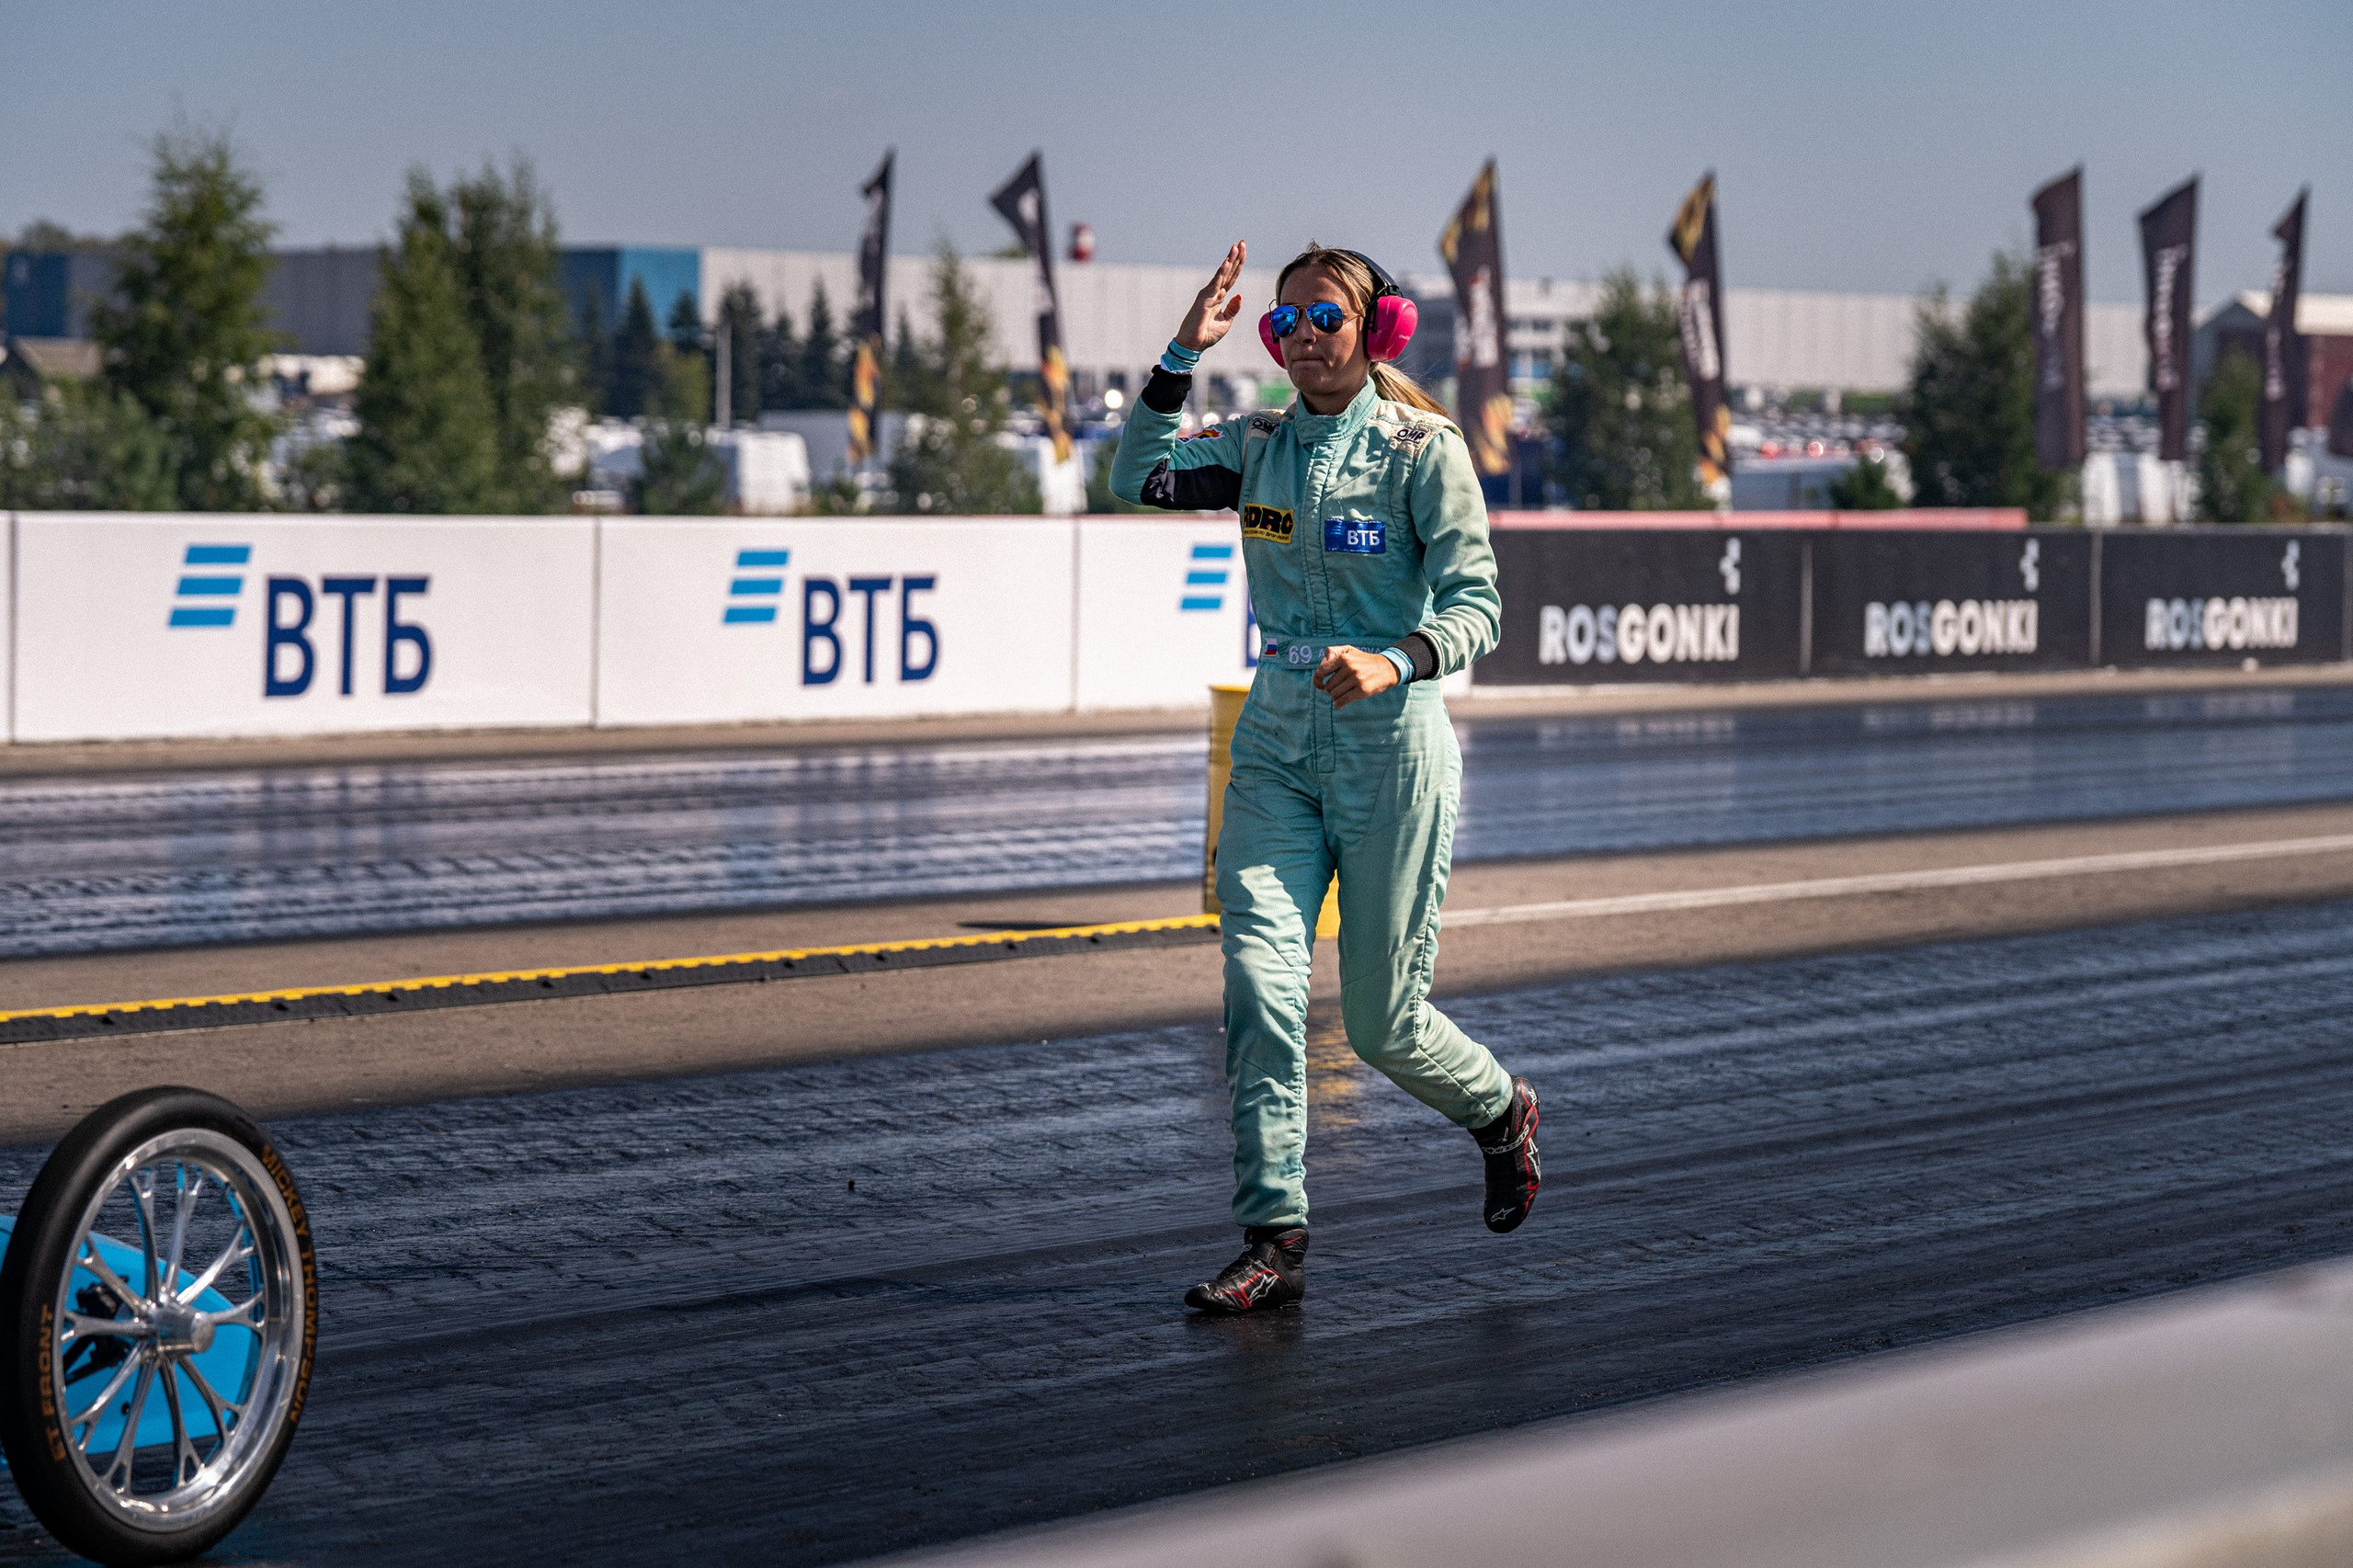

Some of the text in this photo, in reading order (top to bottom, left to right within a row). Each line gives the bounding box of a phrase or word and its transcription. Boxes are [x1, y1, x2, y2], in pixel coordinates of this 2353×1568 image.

[1397, 428, 1425, 441] OMP
[1347, 529, 1381, 546] ВТБ
[264, 574, 432, 697] ВТБ
[801, 574, 939, 686] ВТБ
[1538, 603, 1740, 665] ROSGONKI
[1864, 599, 2039, 658] ROSGONKI
[2144, 596, 2299, 651] ROSGONKI
[1289, 645, 1313, 664] 69
[262, 1145, 318, 1423] MICKEY THOMPSON
[39, 1303, 55, 1416] FRONT
